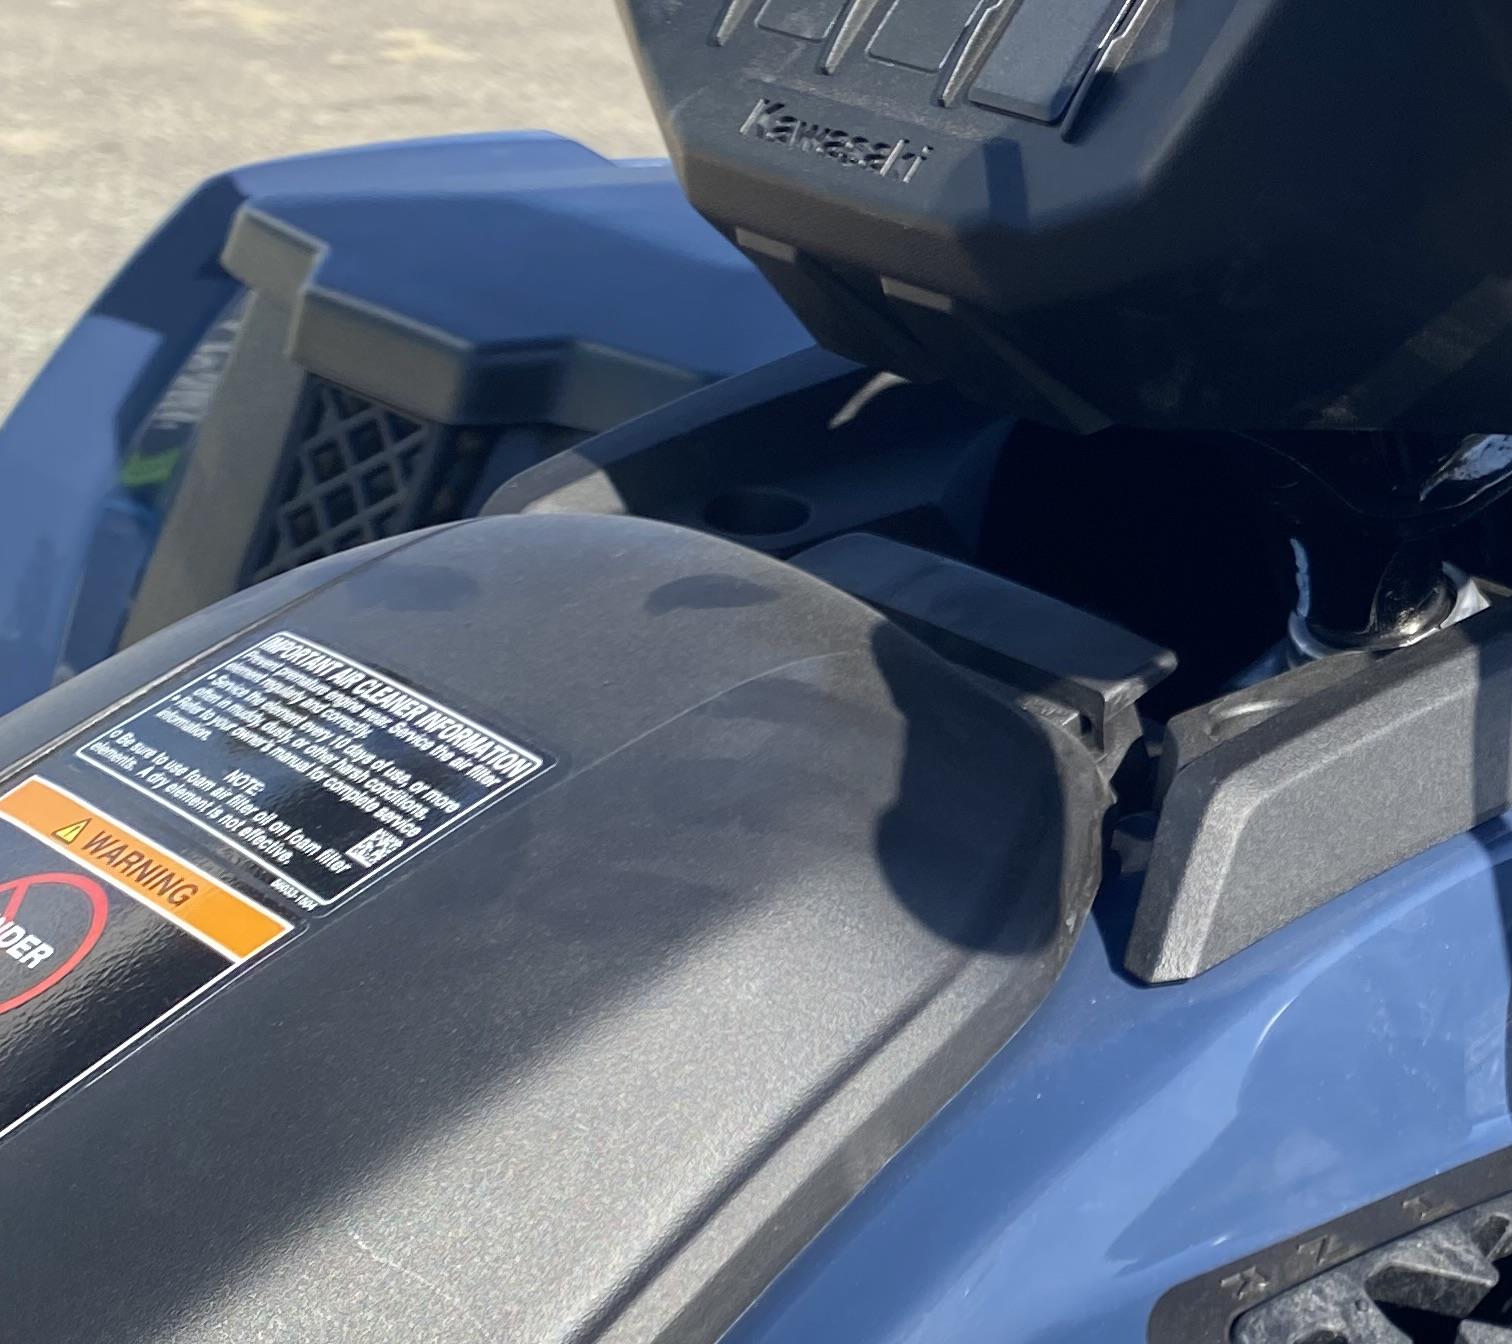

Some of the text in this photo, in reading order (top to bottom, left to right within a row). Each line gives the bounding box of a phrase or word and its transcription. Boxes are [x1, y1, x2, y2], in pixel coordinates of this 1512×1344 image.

[739, 97, 935, 184] Kawasaki
[225, 662, 372, 738] element regularly and correctly.
[261, 637, 530, 776] IMPORTANT AIR CLEANER INFORMATION
[90, 742, 293, 864] elements. A dry element is not effective.
[115, 732, 351, 873] Be sure to use foam air filter oil on foam filter
[193, 688, 428, 820] often in muddy, dusty, or other harsh conditions.
[224, 769, 264, 796] NOTE:
[82, 830, 199, 907] WARNING
